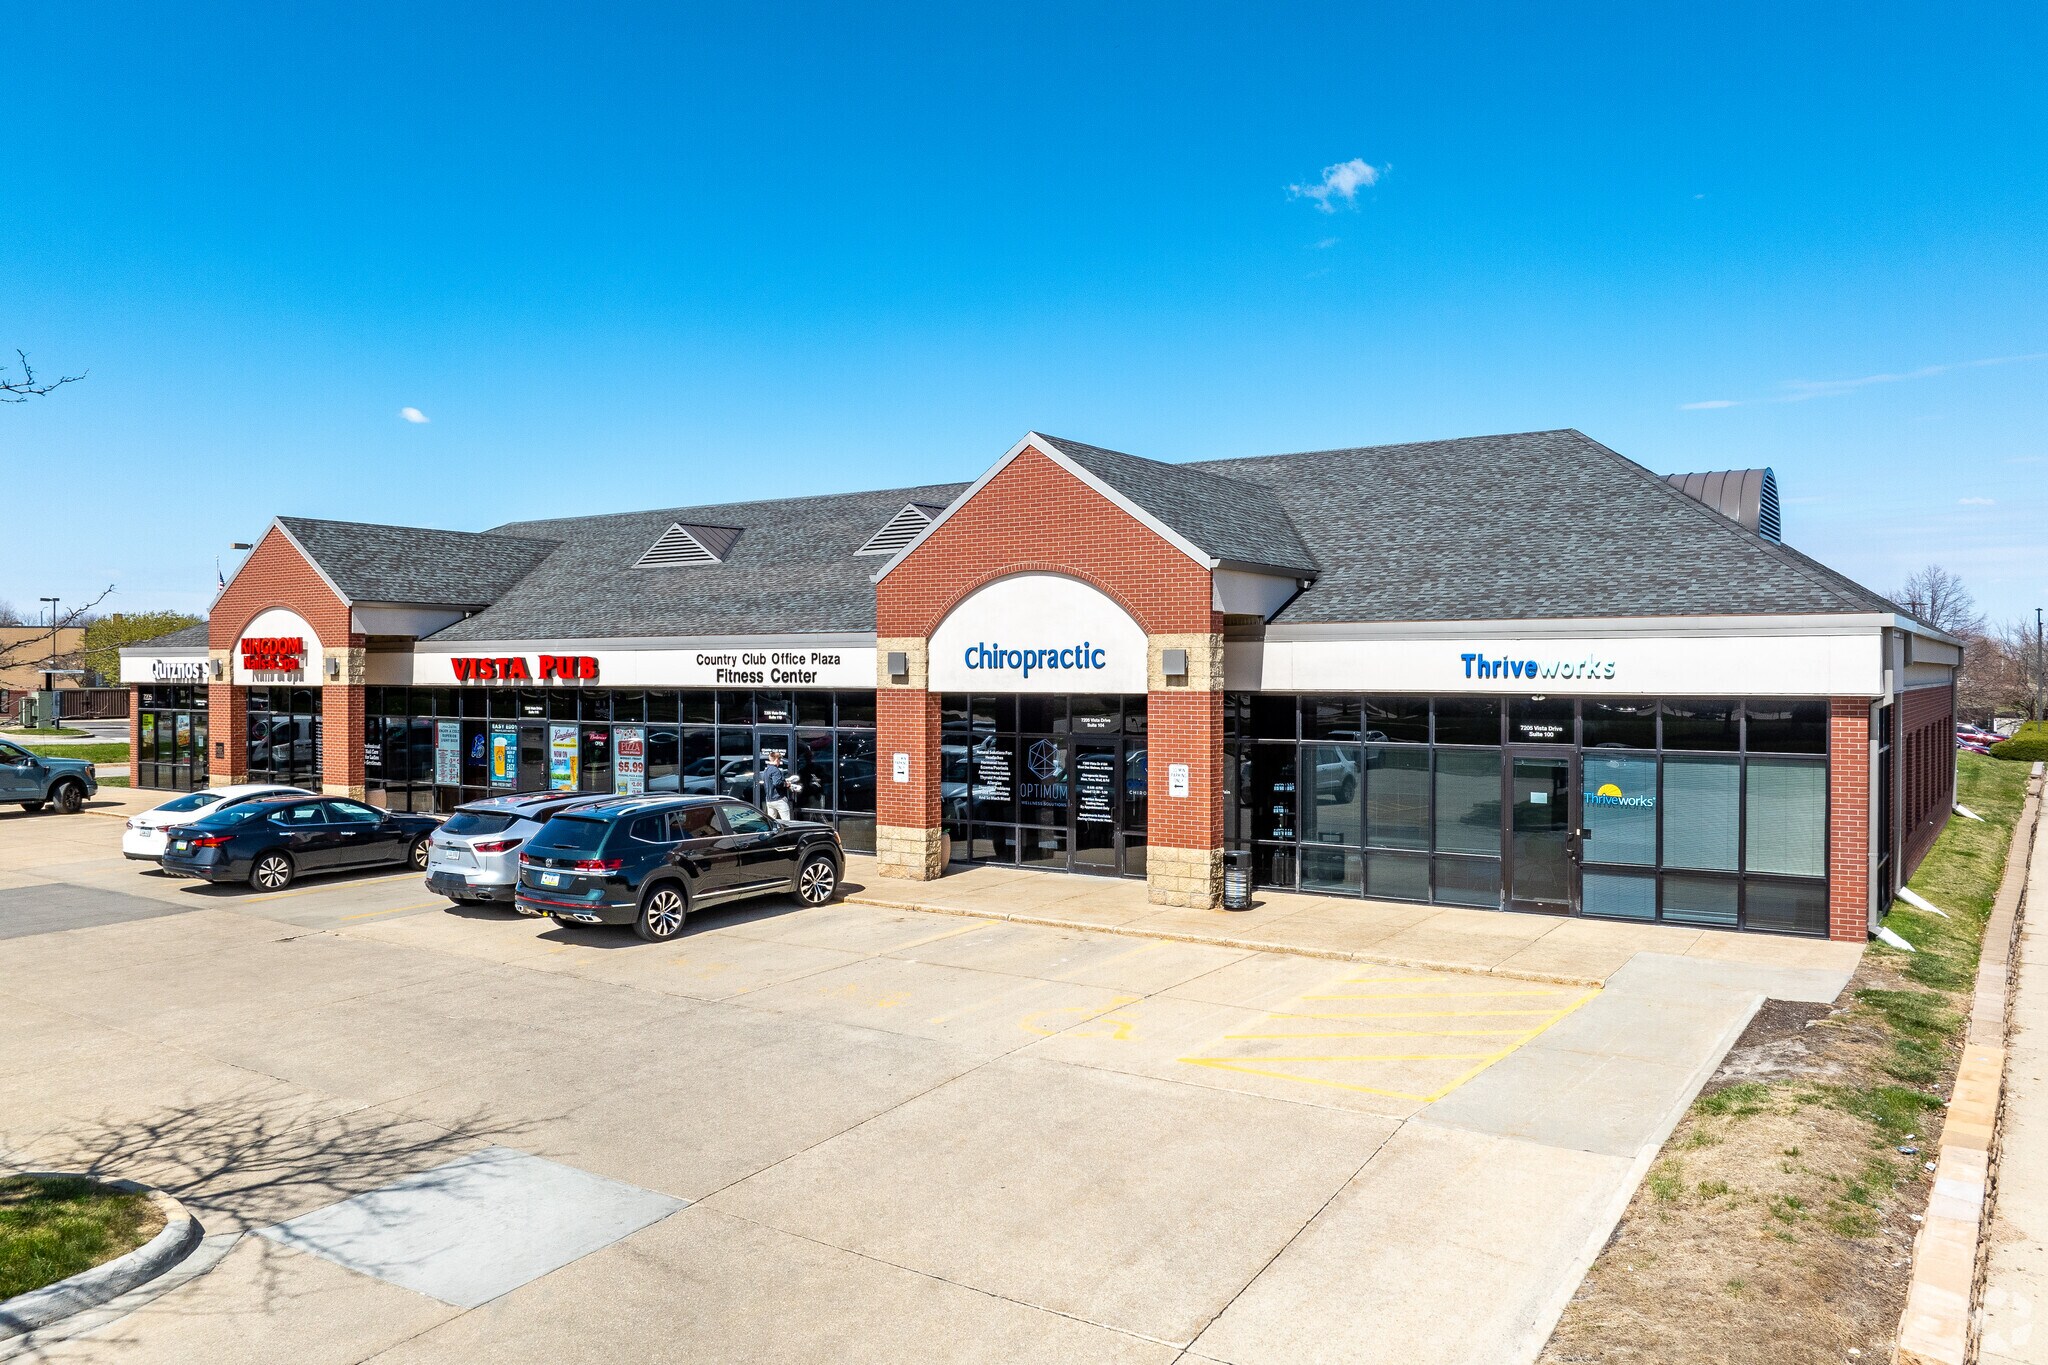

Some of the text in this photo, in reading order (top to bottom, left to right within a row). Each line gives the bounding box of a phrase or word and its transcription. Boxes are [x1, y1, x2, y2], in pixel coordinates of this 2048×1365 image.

[241, 637, 303, 654] KINGDOM
[244, 654, 267, 669] Nails
[278, 654, 299, 672] Spa
[696, 652, 840, 667] Country Club Office Plaza
[965, 642, 1106, 678] Chiropractic
[1461, 653, 1616, 679] Thriveworks
[152, 659, 200, 680] Quiznos
[451, 655, 597, 681] VISTA PUB
[716, 668, 818, 683] Fitness Center
[620, 742, 640, 751] PIZZA
[618, 761, 643, 772] $5.99
[1020, 783, 1068, 799] OPTIMUM
[1583, 792, 1654, 808] Thriveworks
